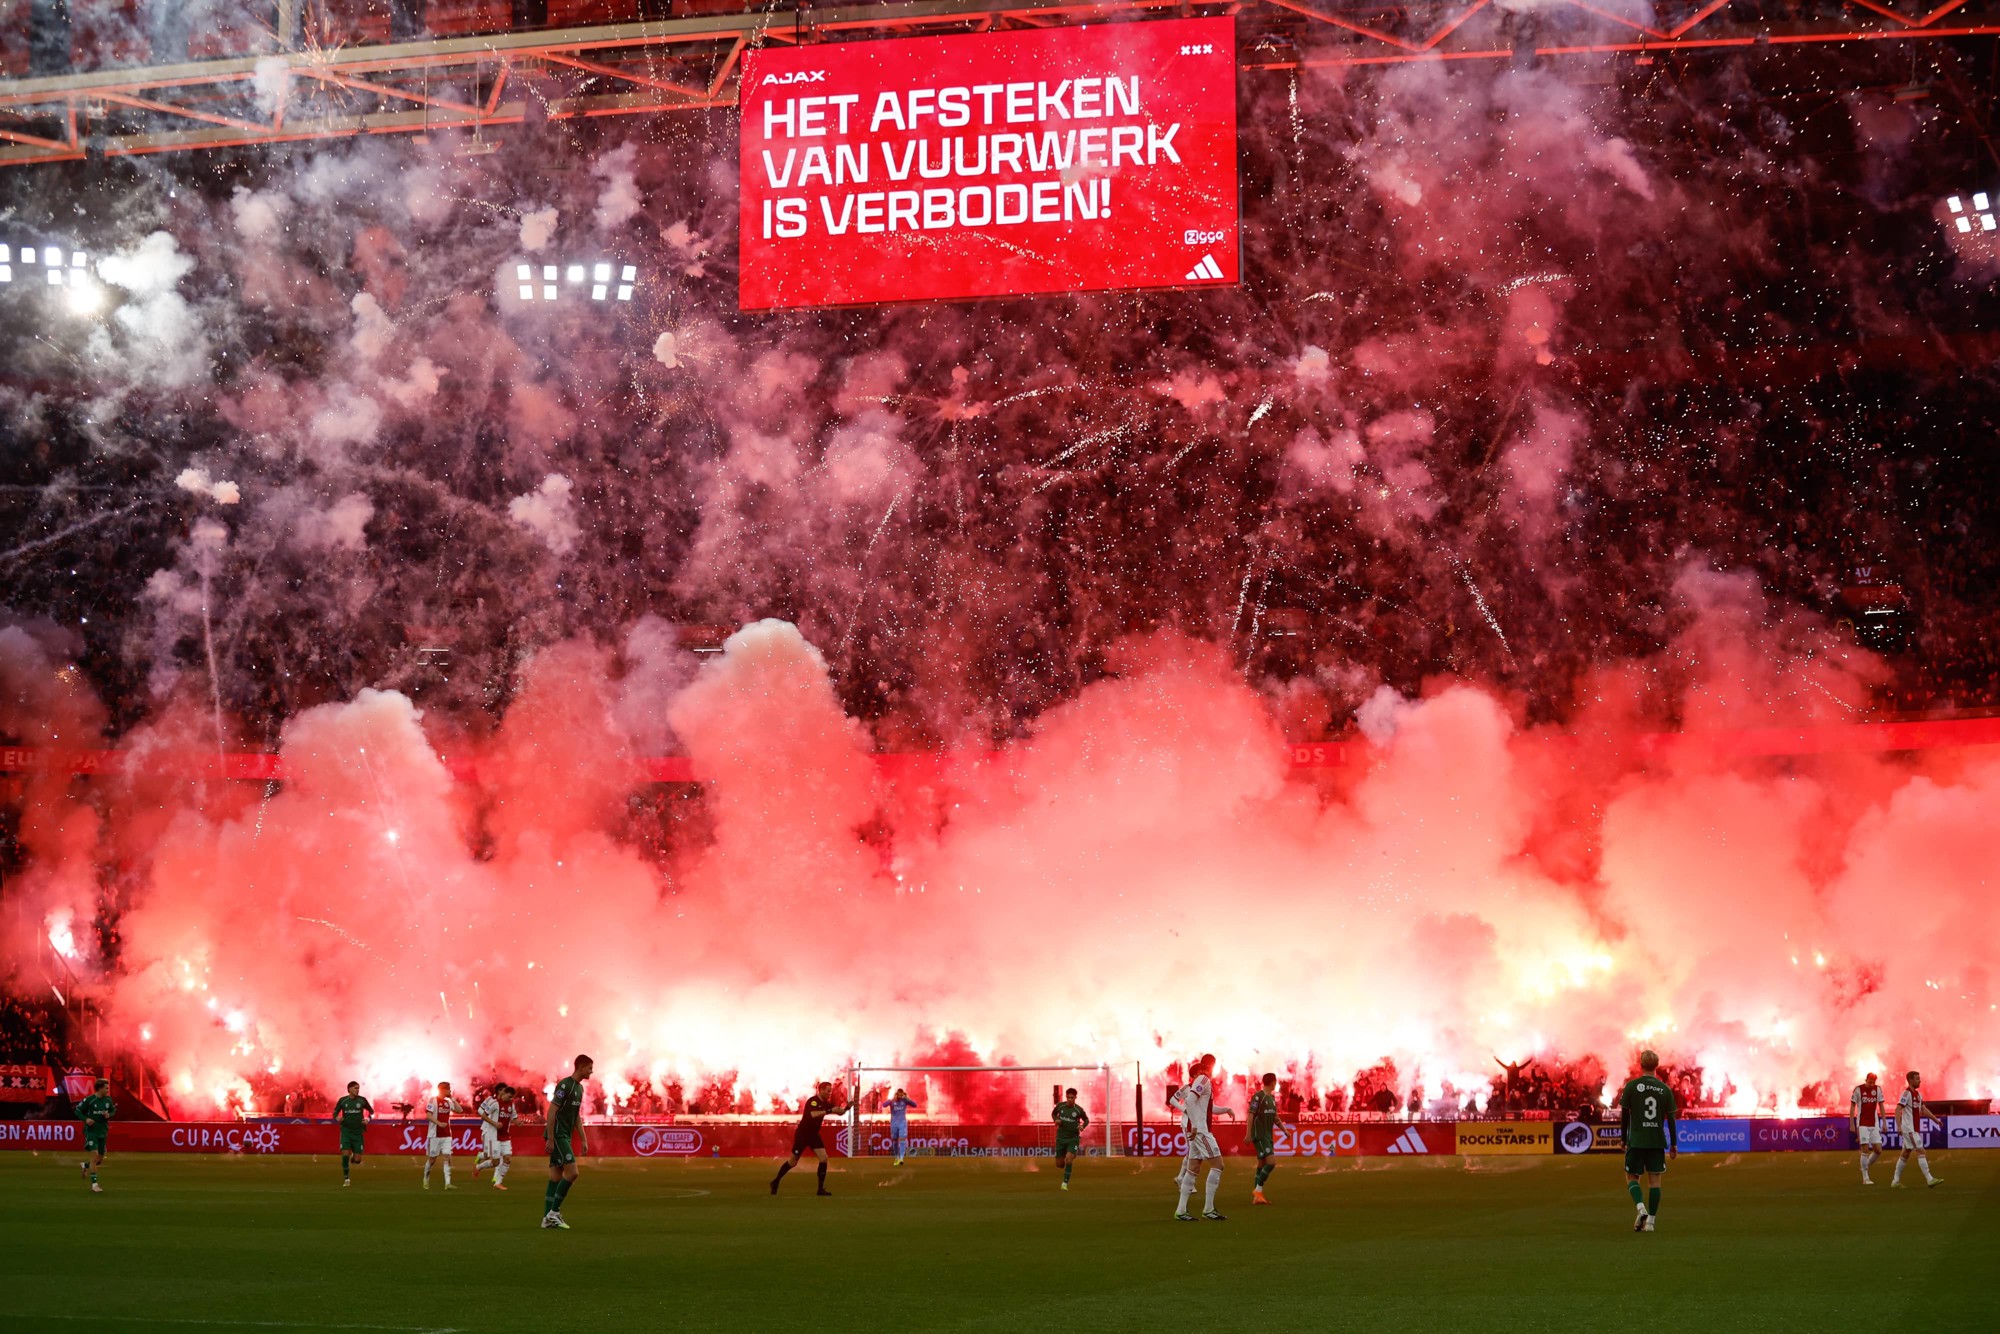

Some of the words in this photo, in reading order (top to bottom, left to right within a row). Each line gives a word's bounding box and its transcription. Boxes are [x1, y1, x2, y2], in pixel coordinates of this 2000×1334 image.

[762, 70, 825, 85] AJAX
[764, 94, 859, 139] HET
[870, 75, 1139, 133] AFSTEKEN
[762, 143, 868, 188] VAN
[881, 123, 1181, 181] VUURWERK
[763, 197, 807, 239] IS
[820, 178, 1111, 235] VERBODEN!
[61, 1066, 95, 1074] VAK
[1646, 1085, 1664, 1093] SPORT
[1645, 1096, 1656, 1120] 3
[400, 1126, 483, 1150] Saals
[666, 1133, 690, 1141] ALLSAFE
[1459, 1134, 1535, 1146] ROCKSTARS
[1538, 1134, 1549, 1145] IT
[1600, 1129, 1622, 1138] ALLSA
[1678, 1130, 1745, 1142] Coinmerce
[1759, 1128, 1836, 1143] CURAÇAO
[868, 1133, 969, 1150] Comerce
[951, 1142, 998, 1157] ALLSAFE
[1001, 1142, 1025, 1157] MINI
[1027, 1142, 1056, 1157] OPSL
